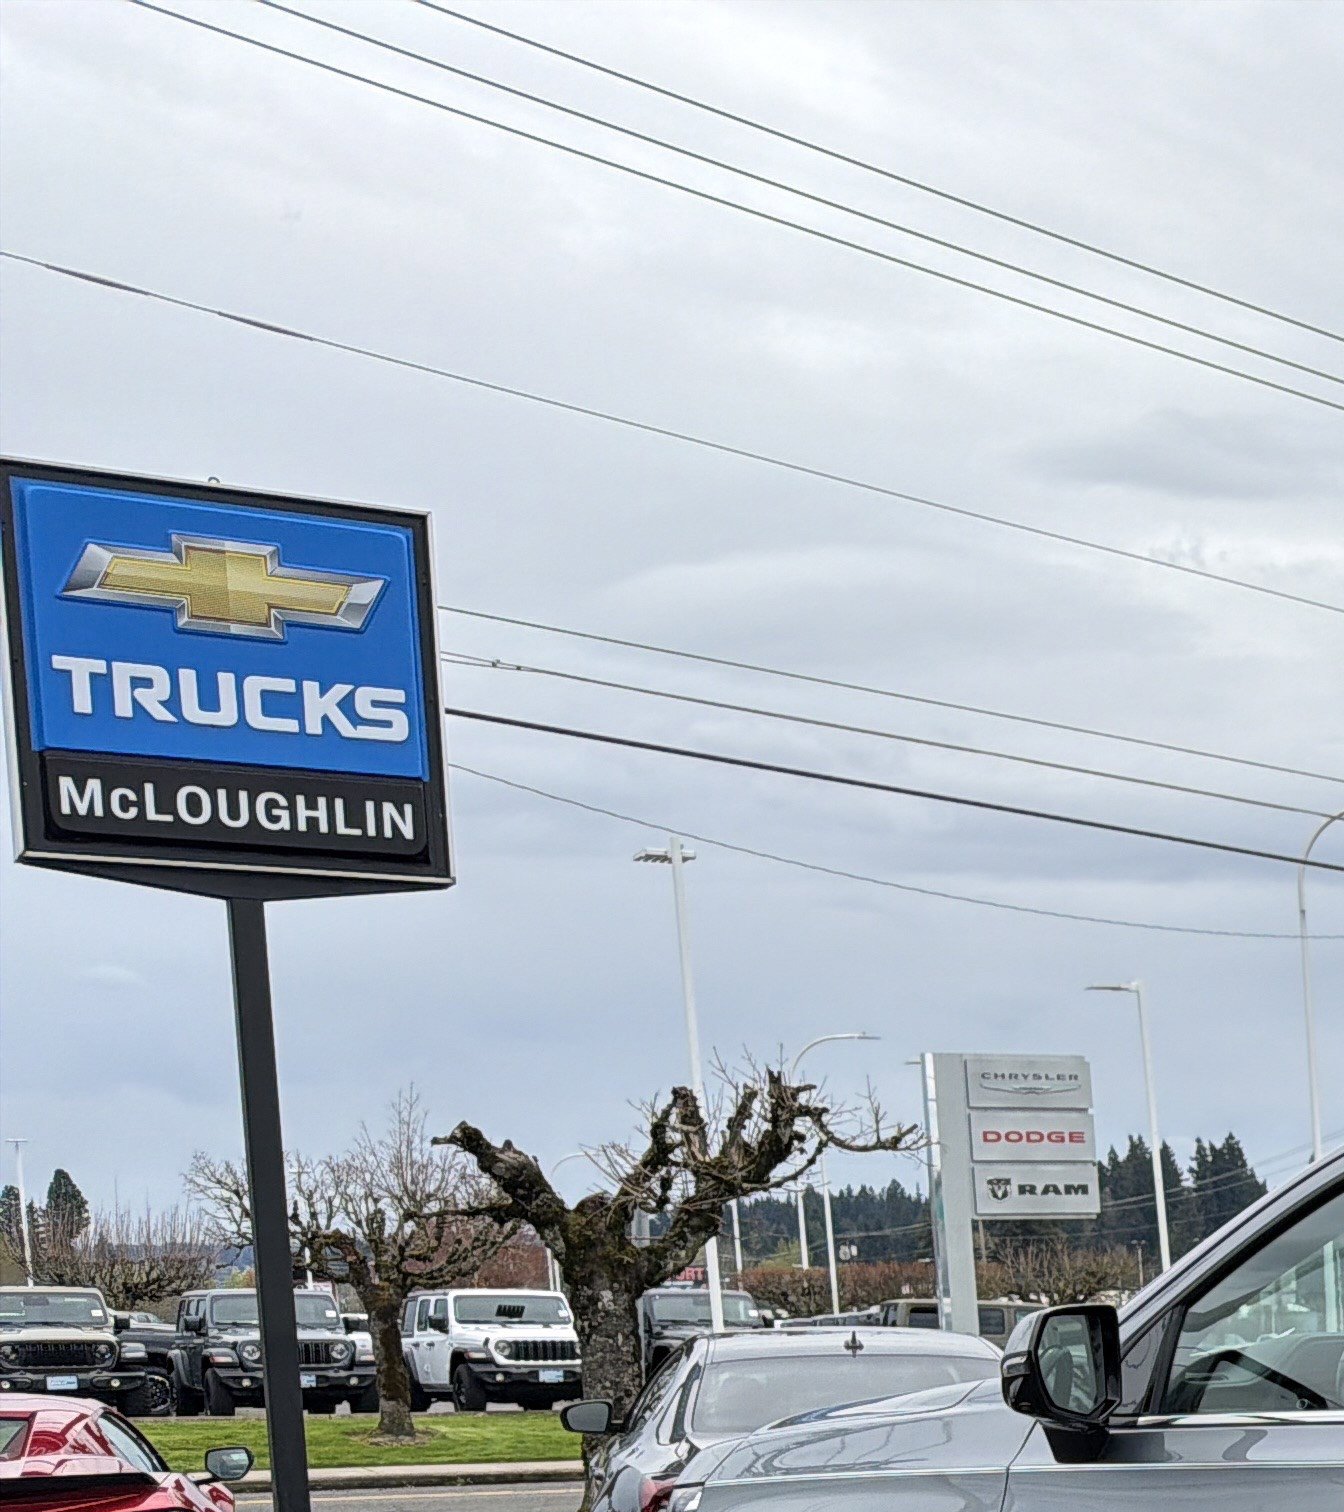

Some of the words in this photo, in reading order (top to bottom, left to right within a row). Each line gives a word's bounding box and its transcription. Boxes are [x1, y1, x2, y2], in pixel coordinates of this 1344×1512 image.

[51, 655, 409, 742] TRUCKS
[58, 776, 414, 840] McLOUGHLIN
[980, 1072, 1079, 1082] CHRYSLER
[982, 1130, 1086, 1144] DODGE
[1017, 1183, 1089, 1196] RAM
